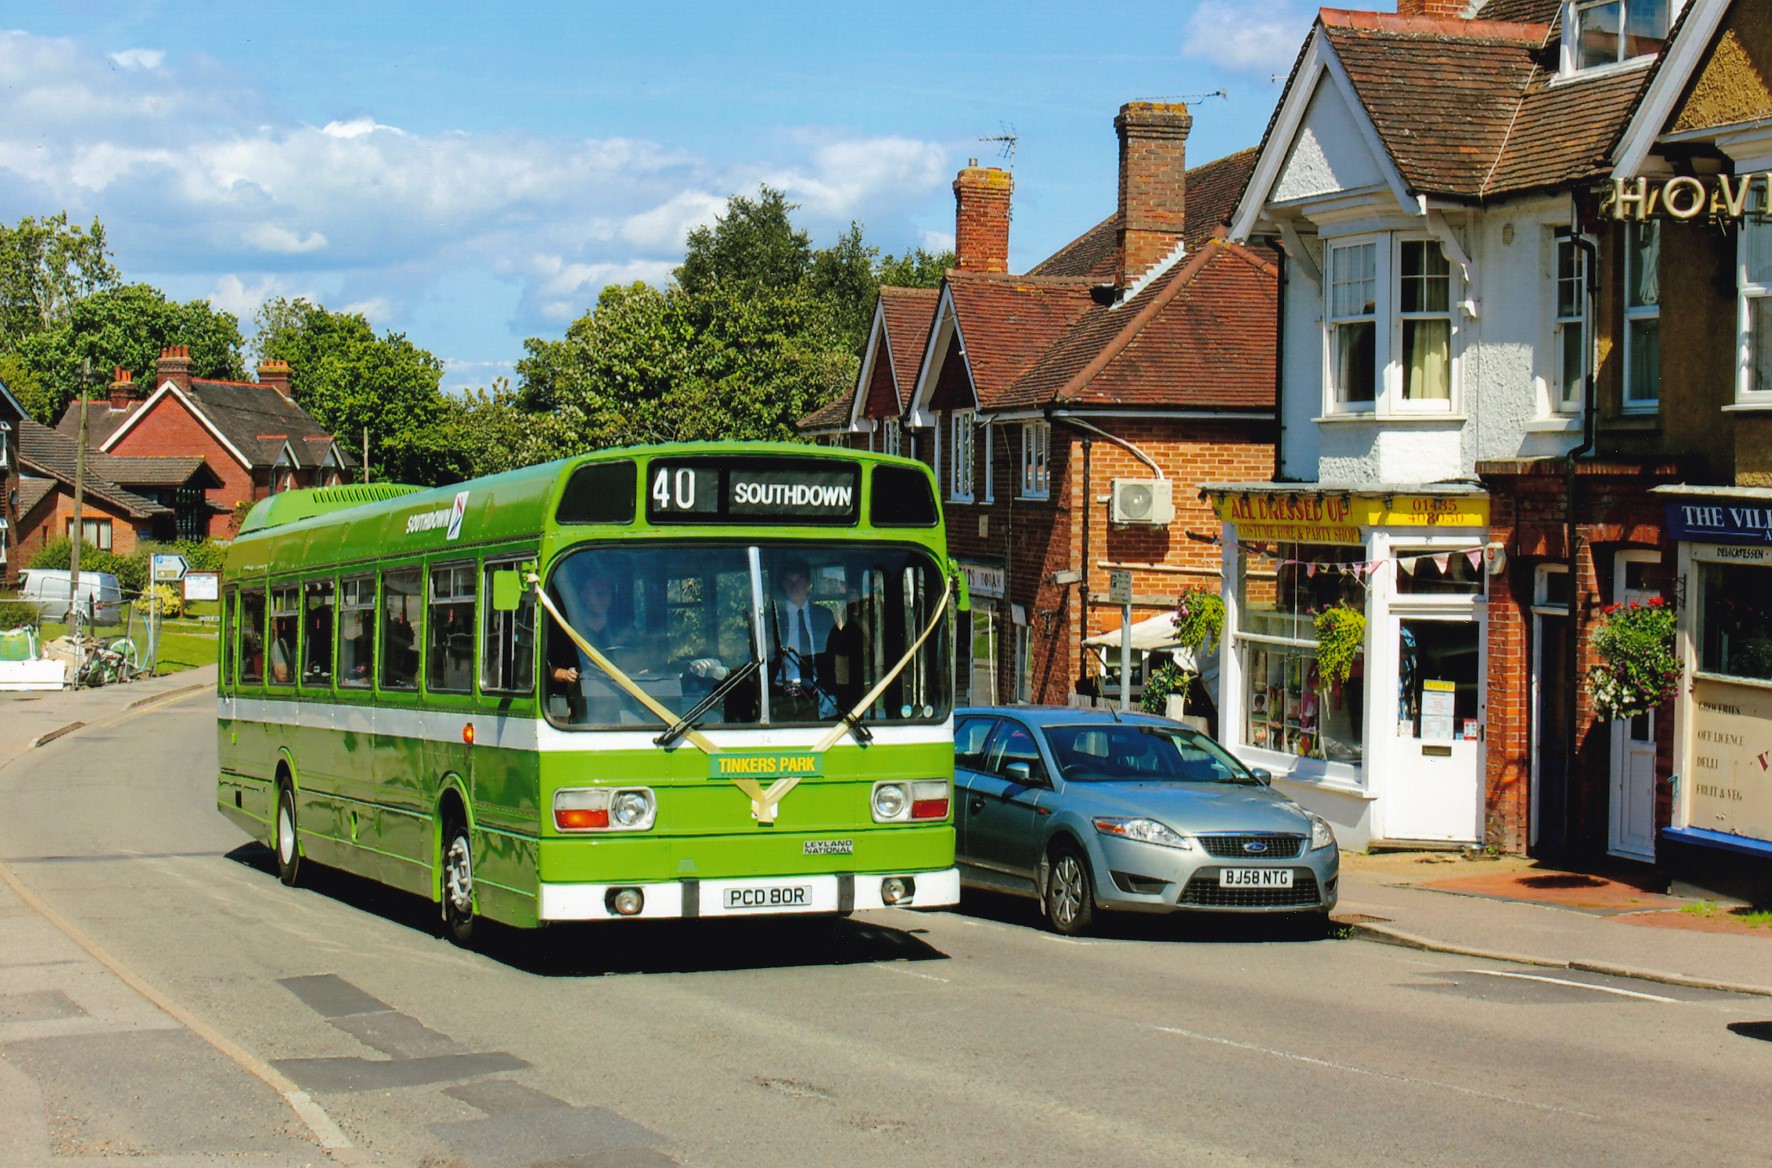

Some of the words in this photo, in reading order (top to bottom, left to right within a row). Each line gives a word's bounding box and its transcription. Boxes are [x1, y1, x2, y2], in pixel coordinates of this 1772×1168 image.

[652, 467, 696, 509] 40
[734, 482, 853, 507] SOUTHDOWN
[1231, 498, 1256, 520] ALL
[1258, 498, 1323, 522] DRESSED
[1326, 498, 1349, 522] UP
[1412, 499, 1457, 511] 01435
[405, 508, 453, 534] SOUTHDOWN
[1681, 505, 1725, 527] THE
[1238, 525, 1274, 539] COSTUME
[1278, 526, 1296, 540] HIRE
[1297, 528, 1304, 540] &
[1306, 527, 1332, 541] PARTY
[1334, 527, 1357, 542] SHOP
[1716, 547, 1764, 559] DELICATESSEN
[1698, 701, 1741, 715] GROCERIES
[1697, 730, 1711, 742] OFF
[1714, 732, 1744, 747] LICENCE
[718, 757, 777, 773] TINKERS
[779, 756, 816, 772] PARK
[1696, 756, 1718, 769] DELLI
[1696, 784, 1718, 797] FRUIT
[1719, 788, 1725, 798] &
[1727, 788, 1742, 801] VEG
[804, 840, 853, 848] LEYLAND
[804, 847, 853, 855] NATIONAL
[1225, 870, 1260, 885] BJ58
[1263, 870, 1288, 885] NTG
[730, 889, 765, 906] PCD
[770, 887, 805, 905] 80R
